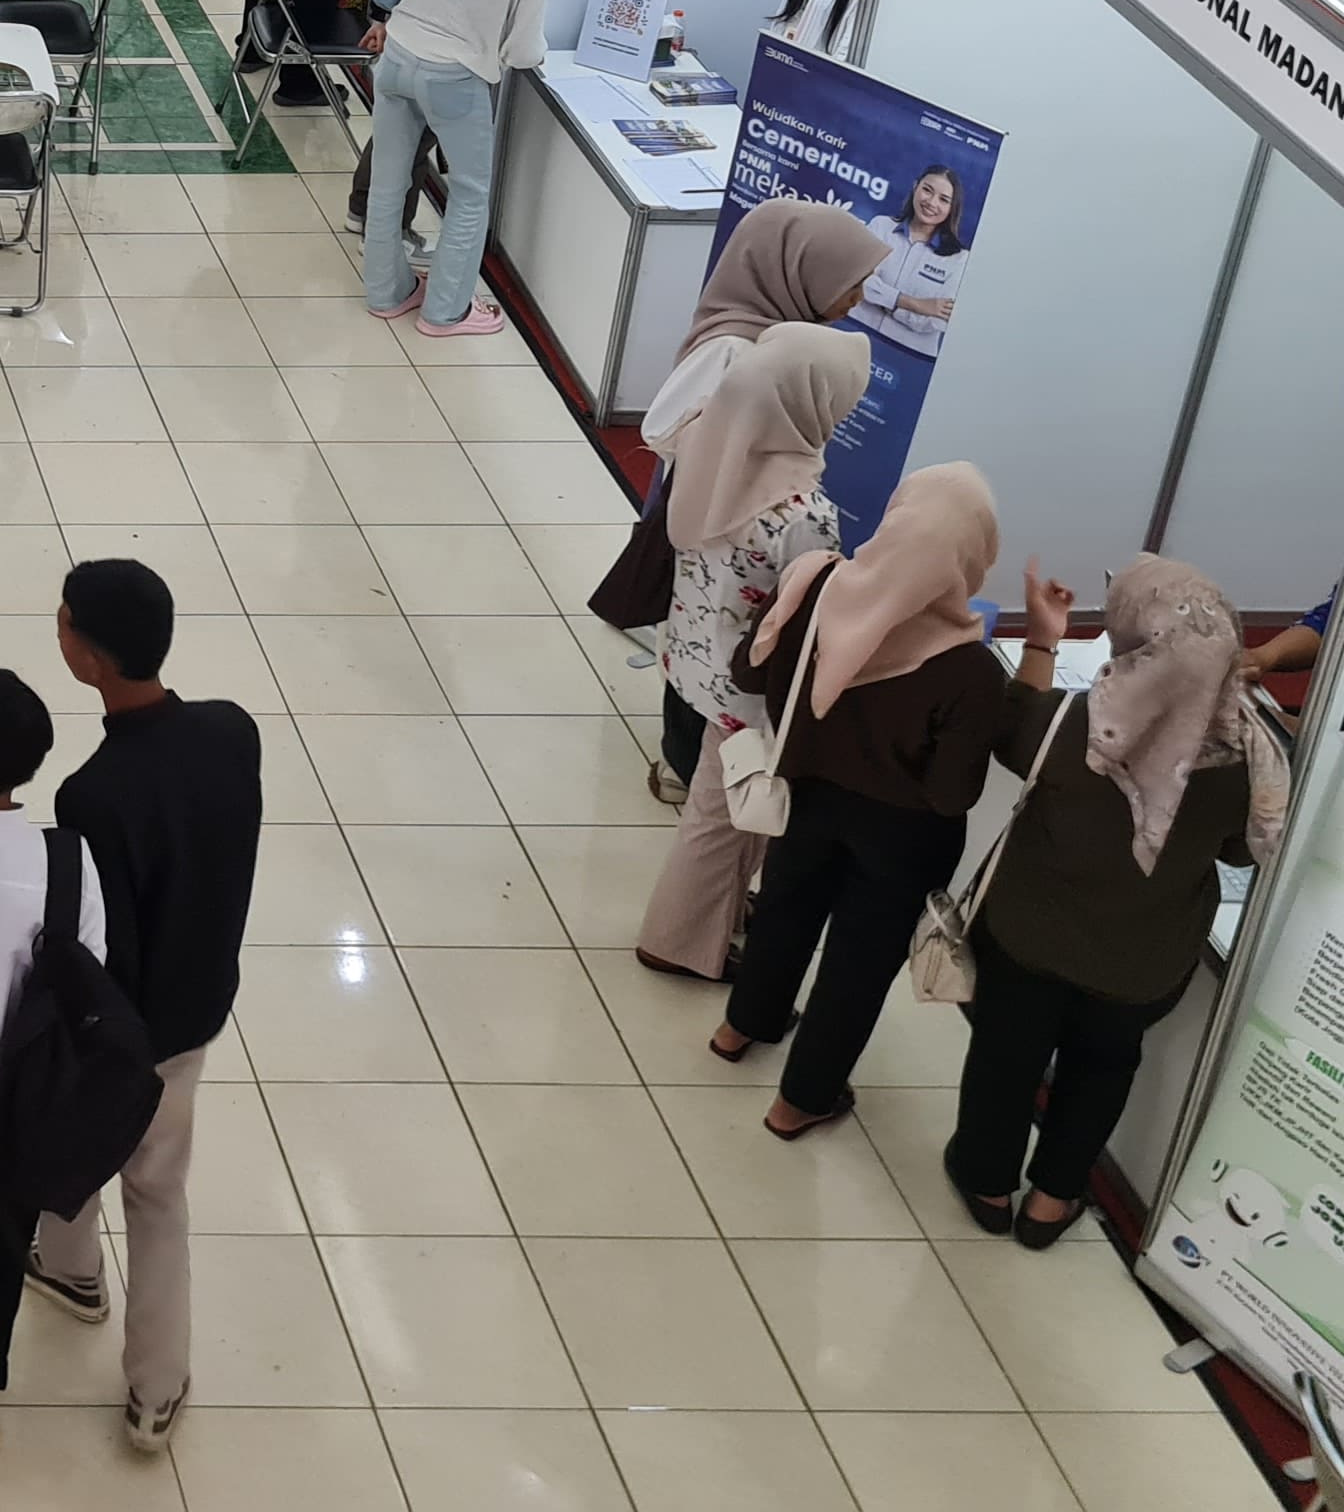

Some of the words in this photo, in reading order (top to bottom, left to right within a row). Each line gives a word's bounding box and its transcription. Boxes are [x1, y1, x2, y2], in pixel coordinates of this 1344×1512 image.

[752, 99, 814, 135] Wujudkan
[816, 127, 848, 150] Karir
[739, 150, 772, 173] PNM
[741, 139, 776, 161] Bersama
[777, 155, 800, 171] kami
[747, 118, 890, 201] Cemerlang
